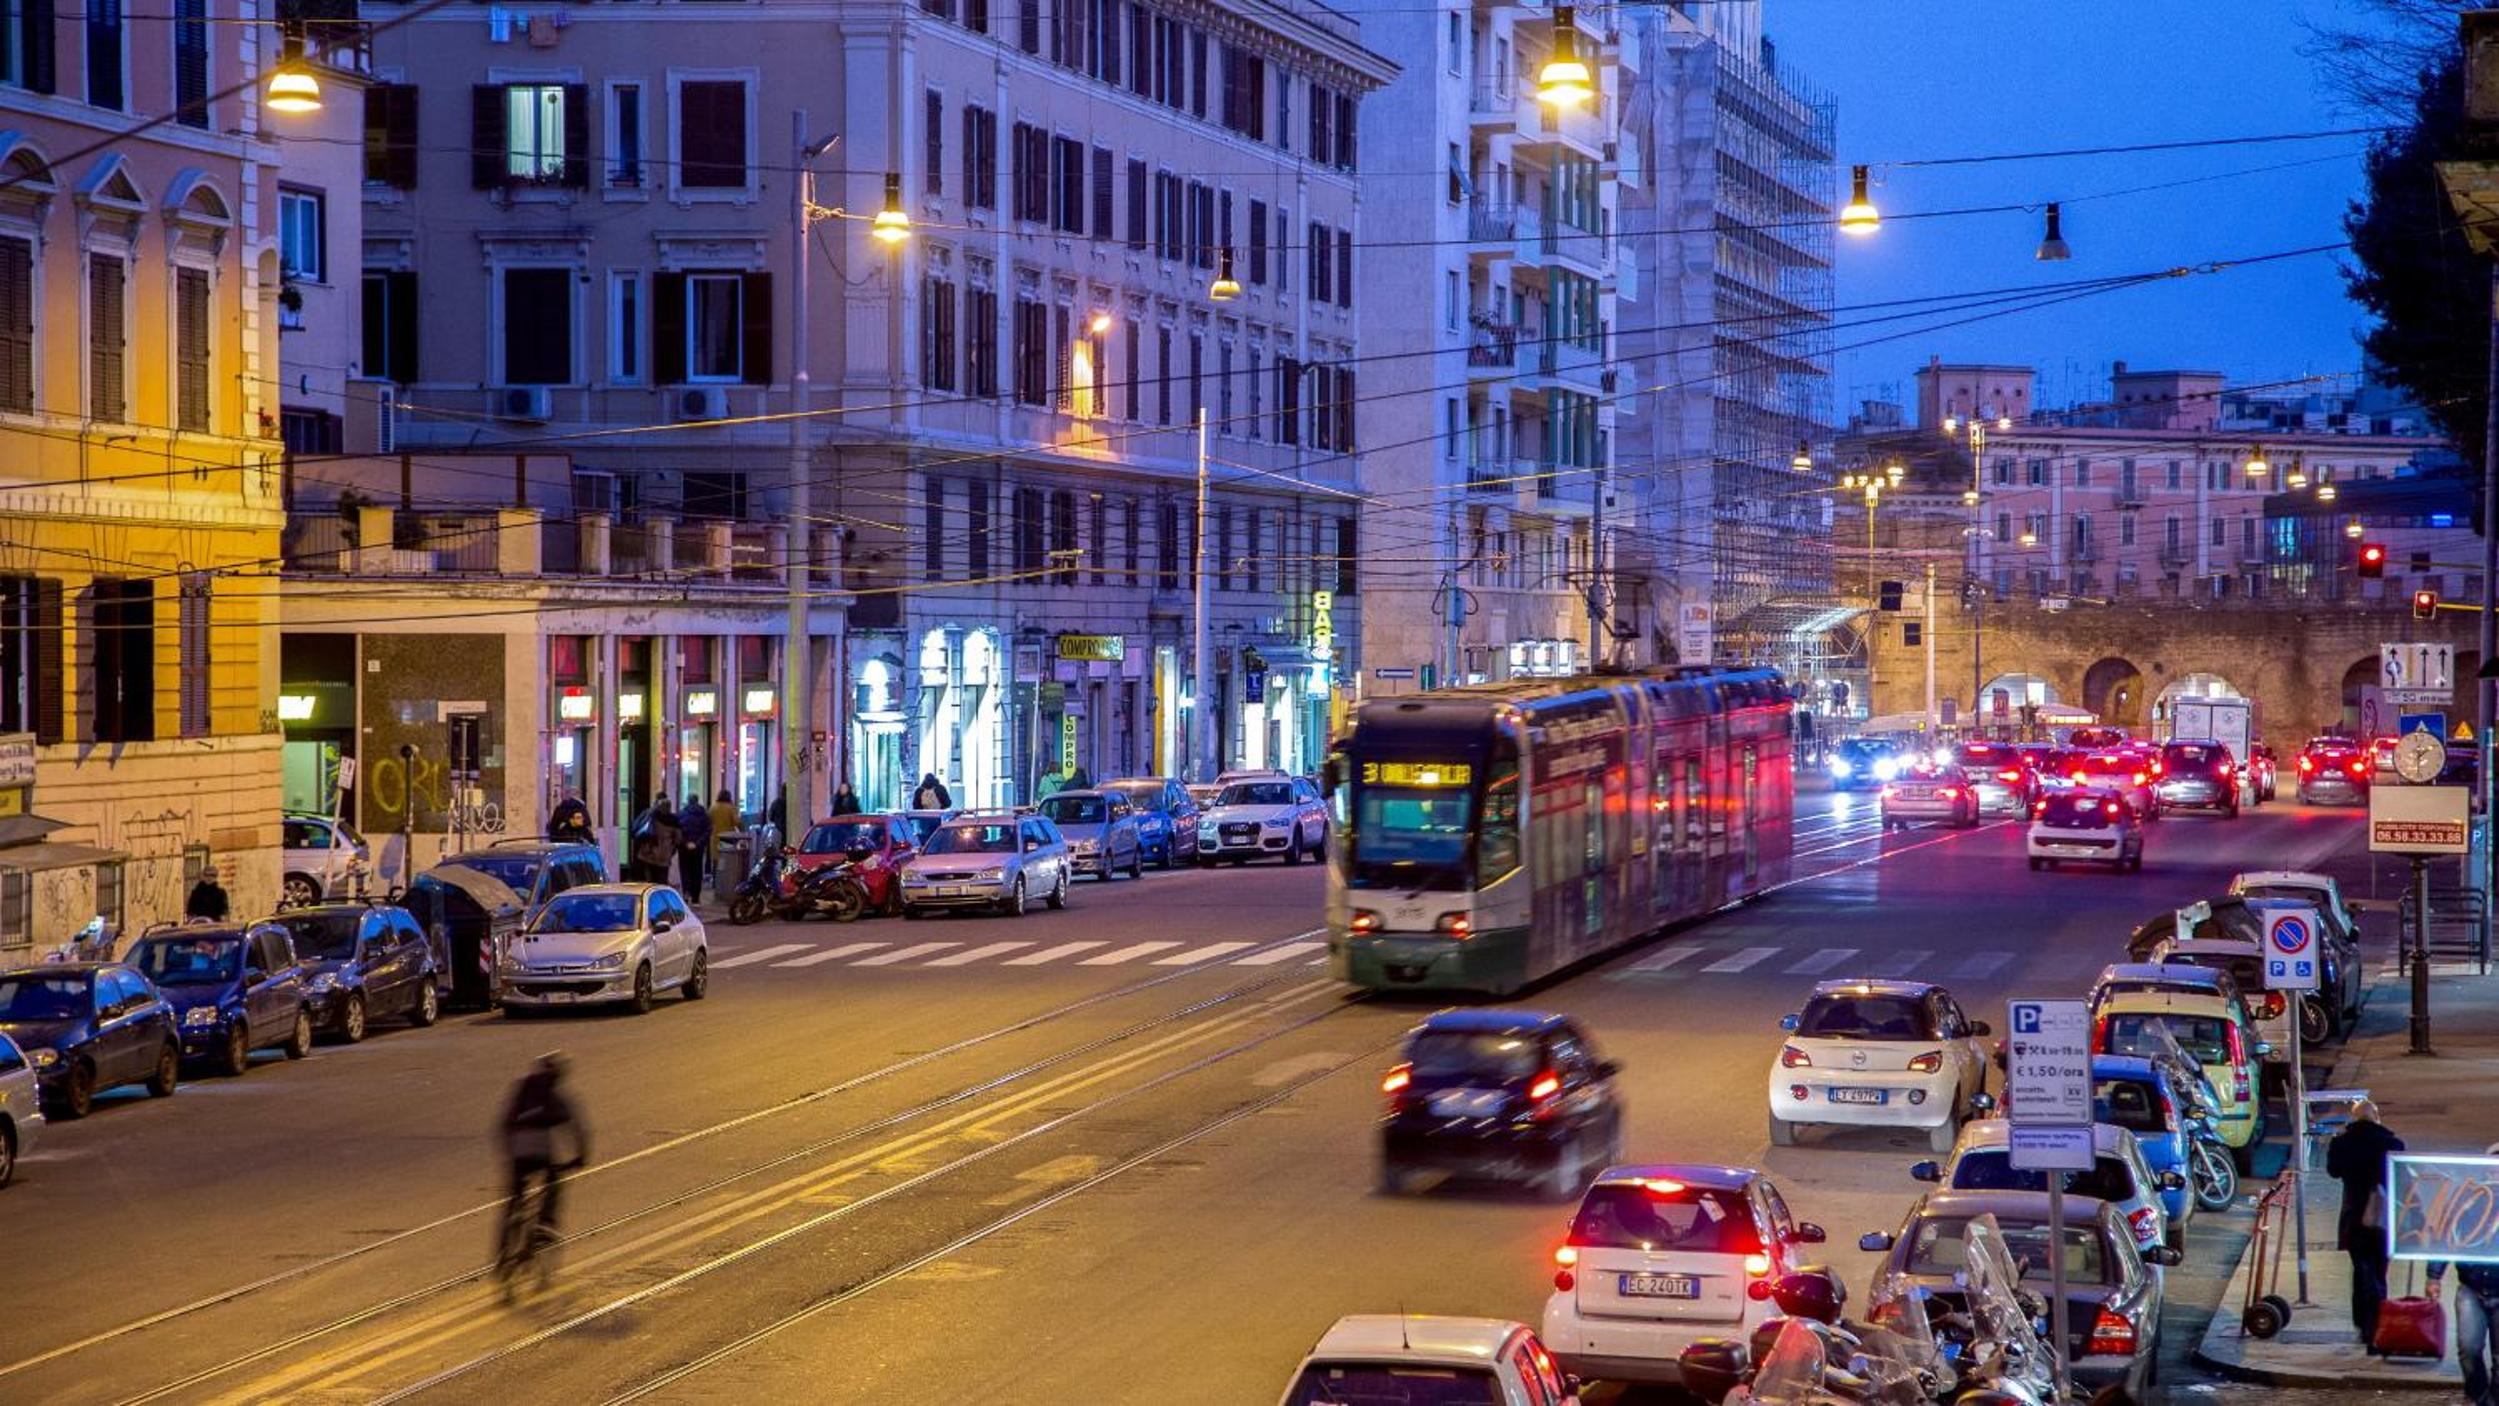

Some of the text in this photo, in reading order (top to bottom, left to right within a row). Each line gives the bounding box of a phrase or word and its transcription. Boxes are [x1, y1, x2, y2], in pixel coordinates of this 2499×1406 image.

[1060, 639, 1099, 655] COMPRO
[1362, 762, 1378, 784] 3
[2019, 1007, 2038, 1032] P
